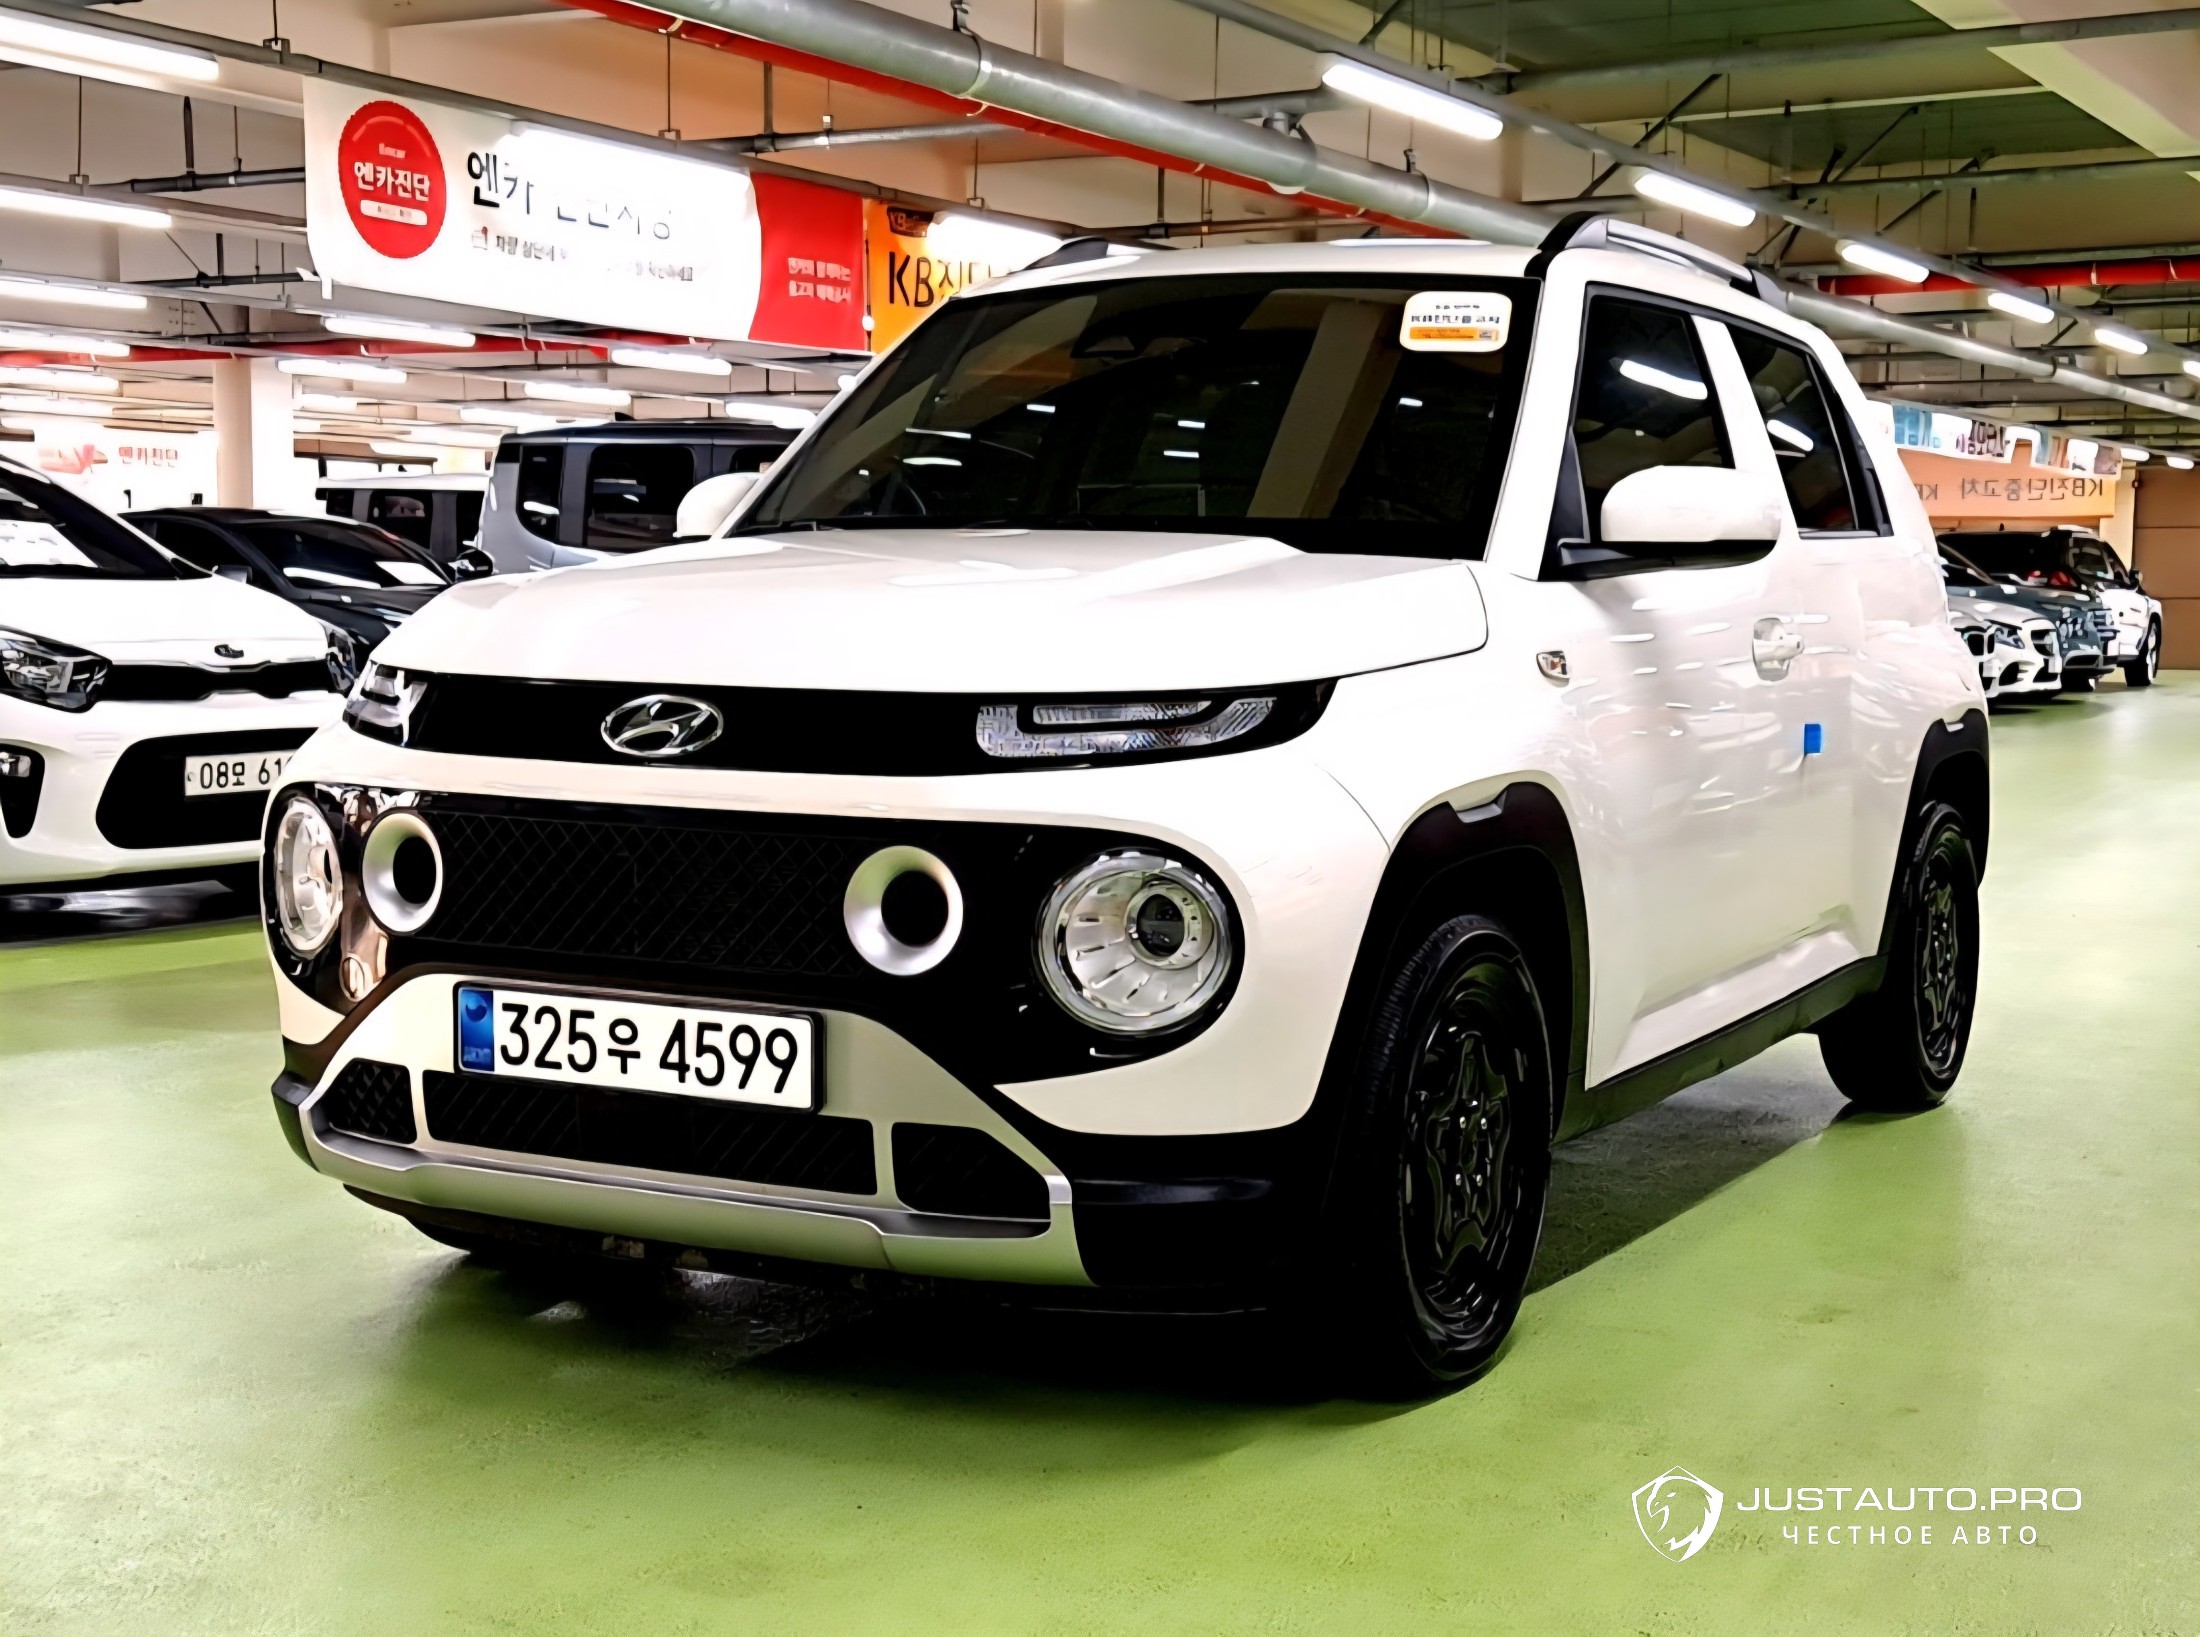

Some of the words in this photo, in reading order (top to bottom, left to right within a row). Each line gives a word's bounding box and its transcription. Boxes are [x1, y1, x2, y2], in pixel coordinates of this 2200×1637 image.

[354, 161, 430, 202] 엔카진단
[200, 761, 245, 789] 08모
[258, 755, 294, 785] 61
[500, 1003, 640, 1075] 325우
[658, 1018, 798, 1094] 4599
